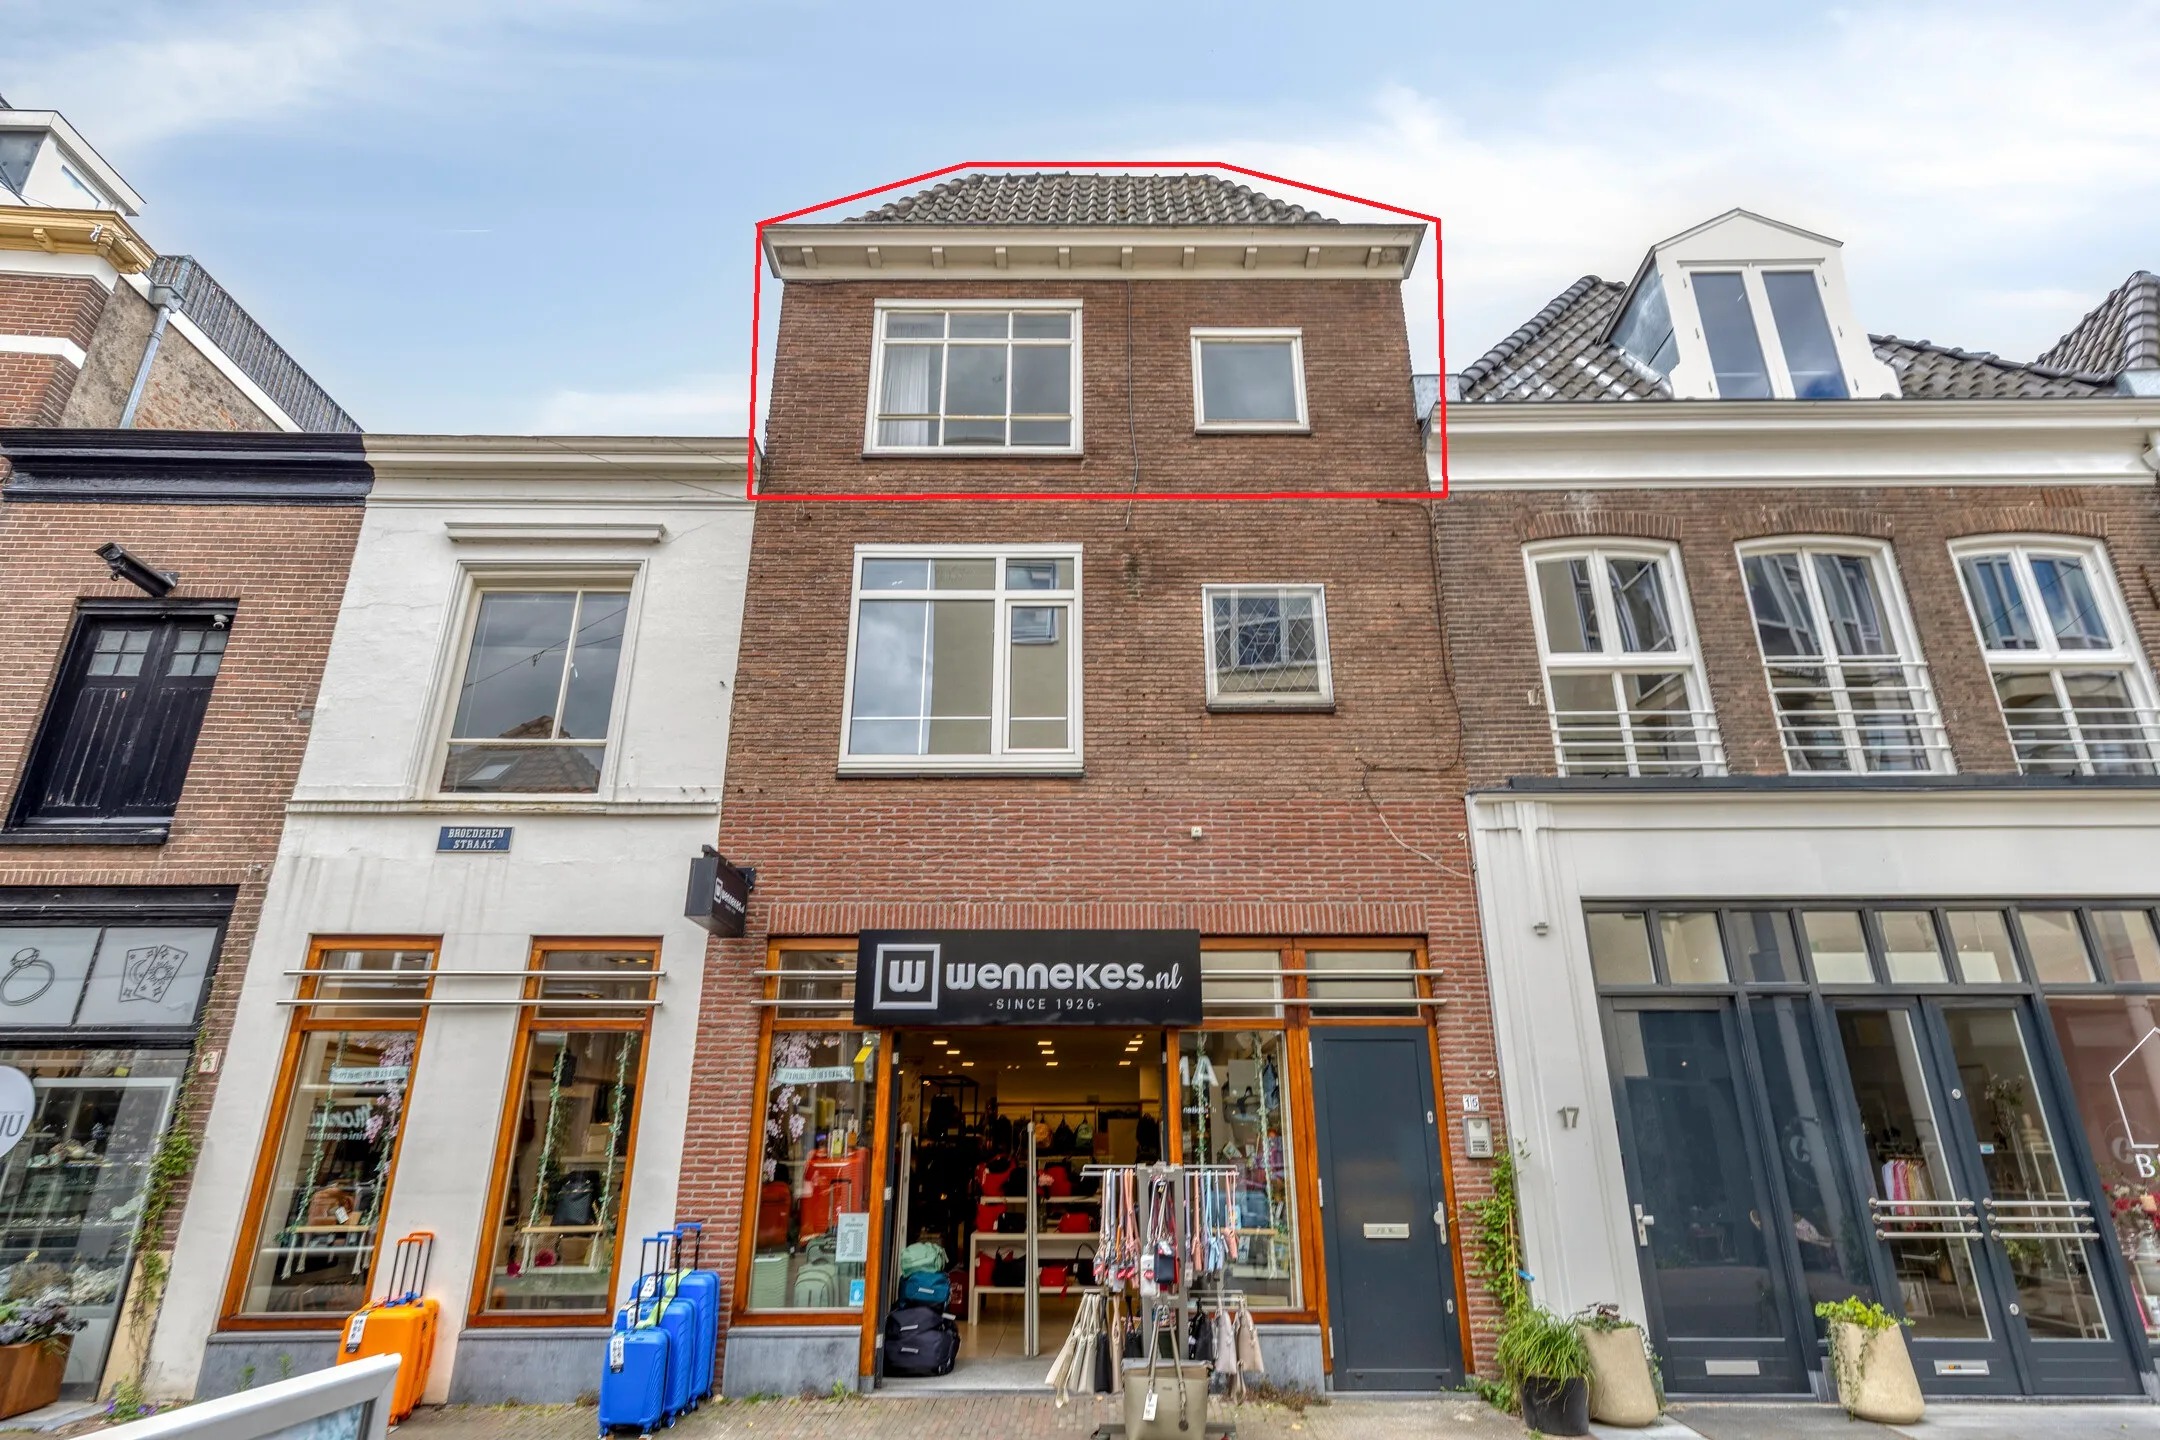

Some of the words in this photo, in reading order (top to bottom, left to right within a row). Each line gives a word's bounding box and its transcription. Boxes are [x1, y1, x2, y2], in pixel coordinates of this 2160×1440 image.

[447, 828, 505, 839] BROEDEREN
[945, 961, 1184, 991] wennekes.nl
[1557, 1106, 1580, 1128] 17
[2135, 1153, 2160, 1178] B
